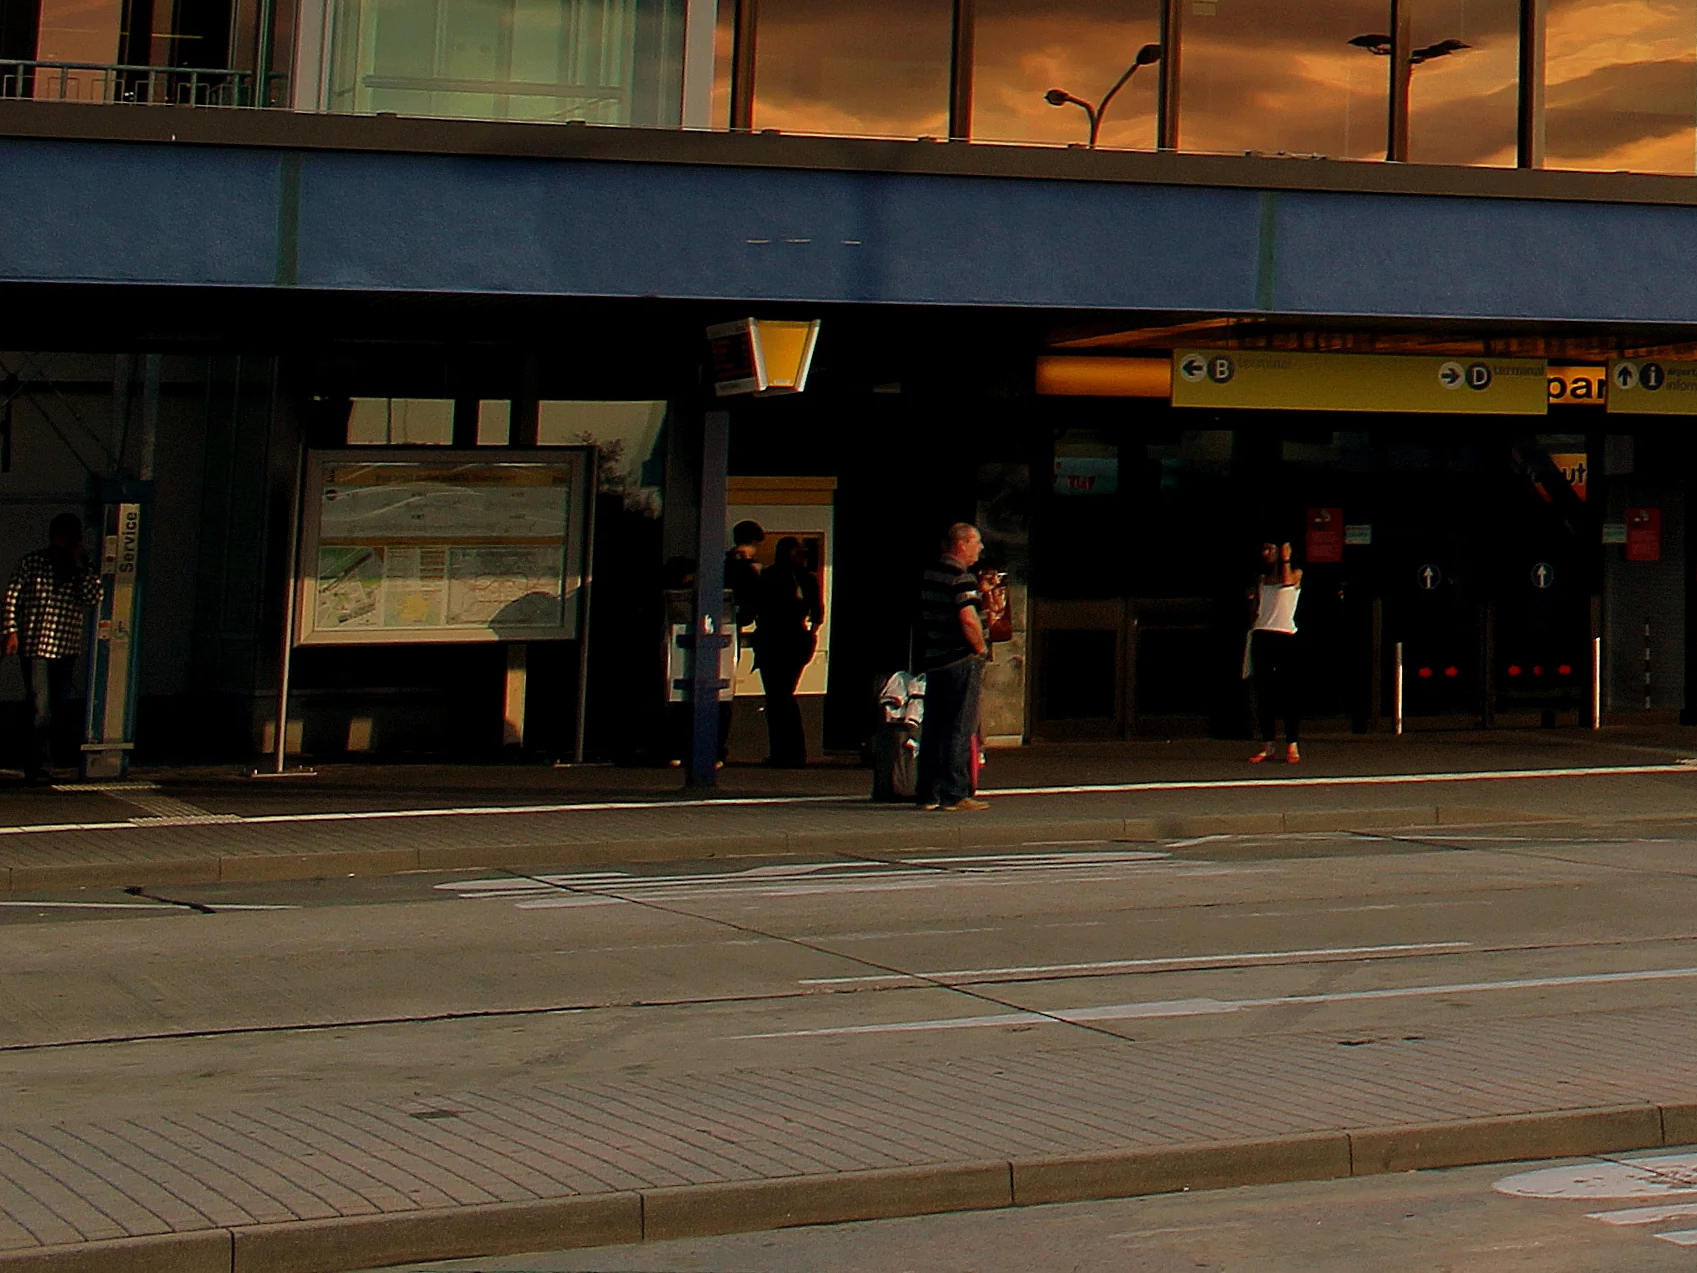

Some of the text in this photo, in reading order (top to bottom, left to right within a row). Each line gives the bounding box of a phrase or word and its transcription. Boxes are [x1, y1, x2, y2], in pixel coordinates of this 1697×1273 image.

[1215, 360, 1229, 379] B
[1471, 366, 1486, 385] D
[120, 511, 138, 573] Service
